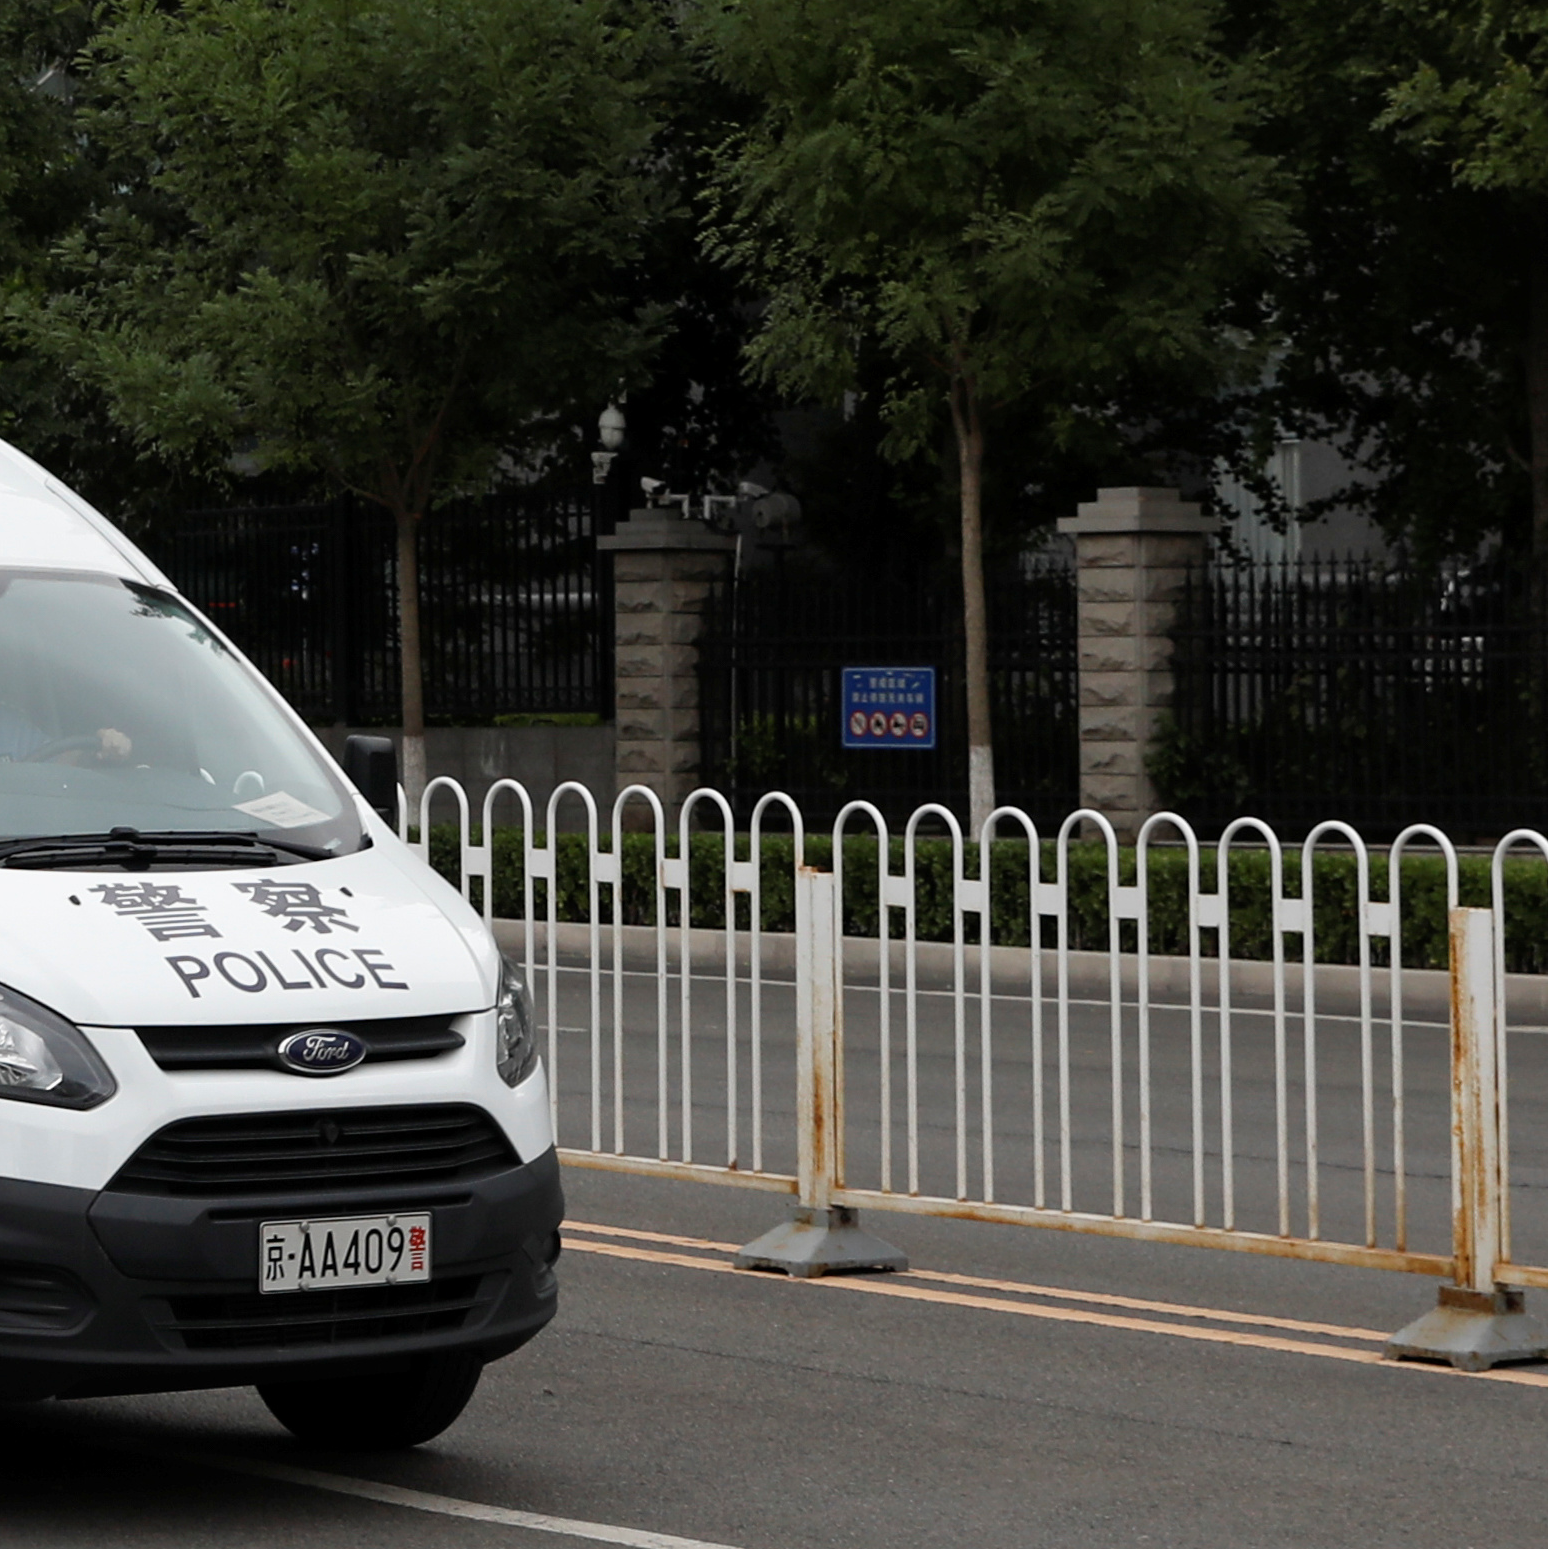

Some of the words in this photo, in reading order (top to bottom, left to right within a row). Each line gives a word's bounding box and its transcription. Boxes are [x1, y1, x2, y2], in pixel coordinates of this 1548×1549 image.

[87, 878, 361, 942] 警察
[164, 947, 411, 999] POLICE
[302, 1035, 350, 1064] Ford
